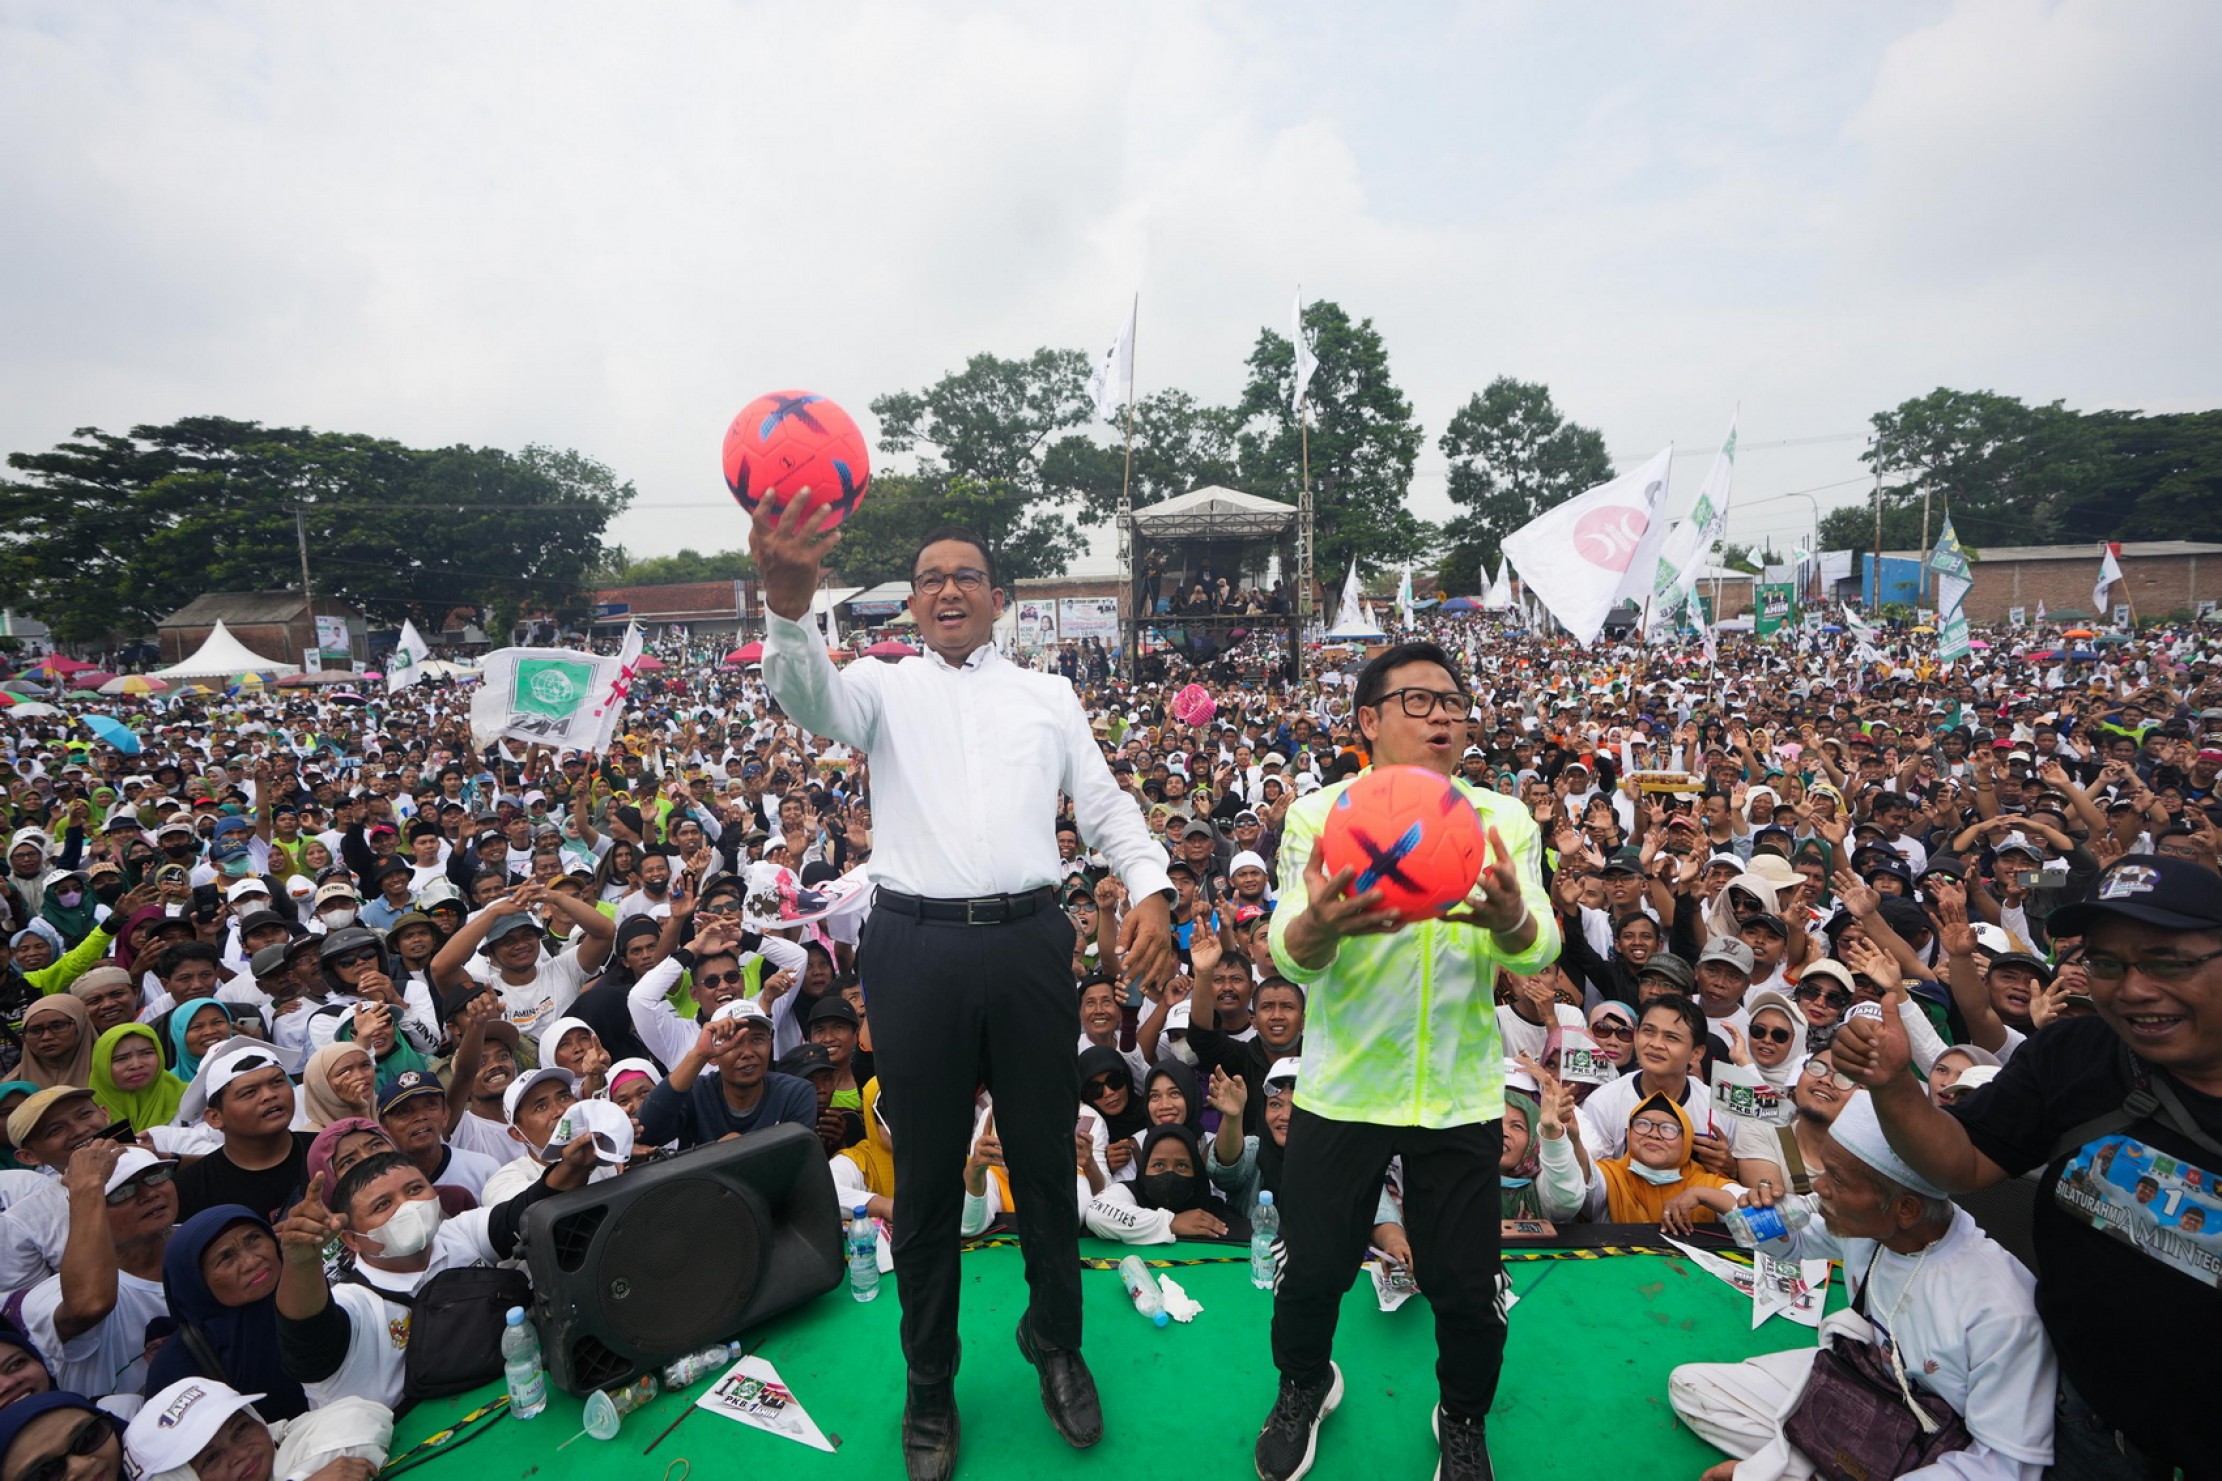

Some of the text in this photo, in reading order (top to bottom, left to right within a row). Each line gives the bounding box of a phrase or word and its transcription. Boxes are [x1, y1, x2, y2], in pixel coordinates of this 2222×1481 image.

[1729, 1102, 1751, 1115] PKB
[2181, 1181, 2200, 1194] PKS
[2162, 1188, 2184, 1217] 1
[2055, 1179, 2123, 1226] SILATURAHMI
[2118, 1206, 2198, 1266] AMIN
[724, 1395, 748, 1408] PKB
